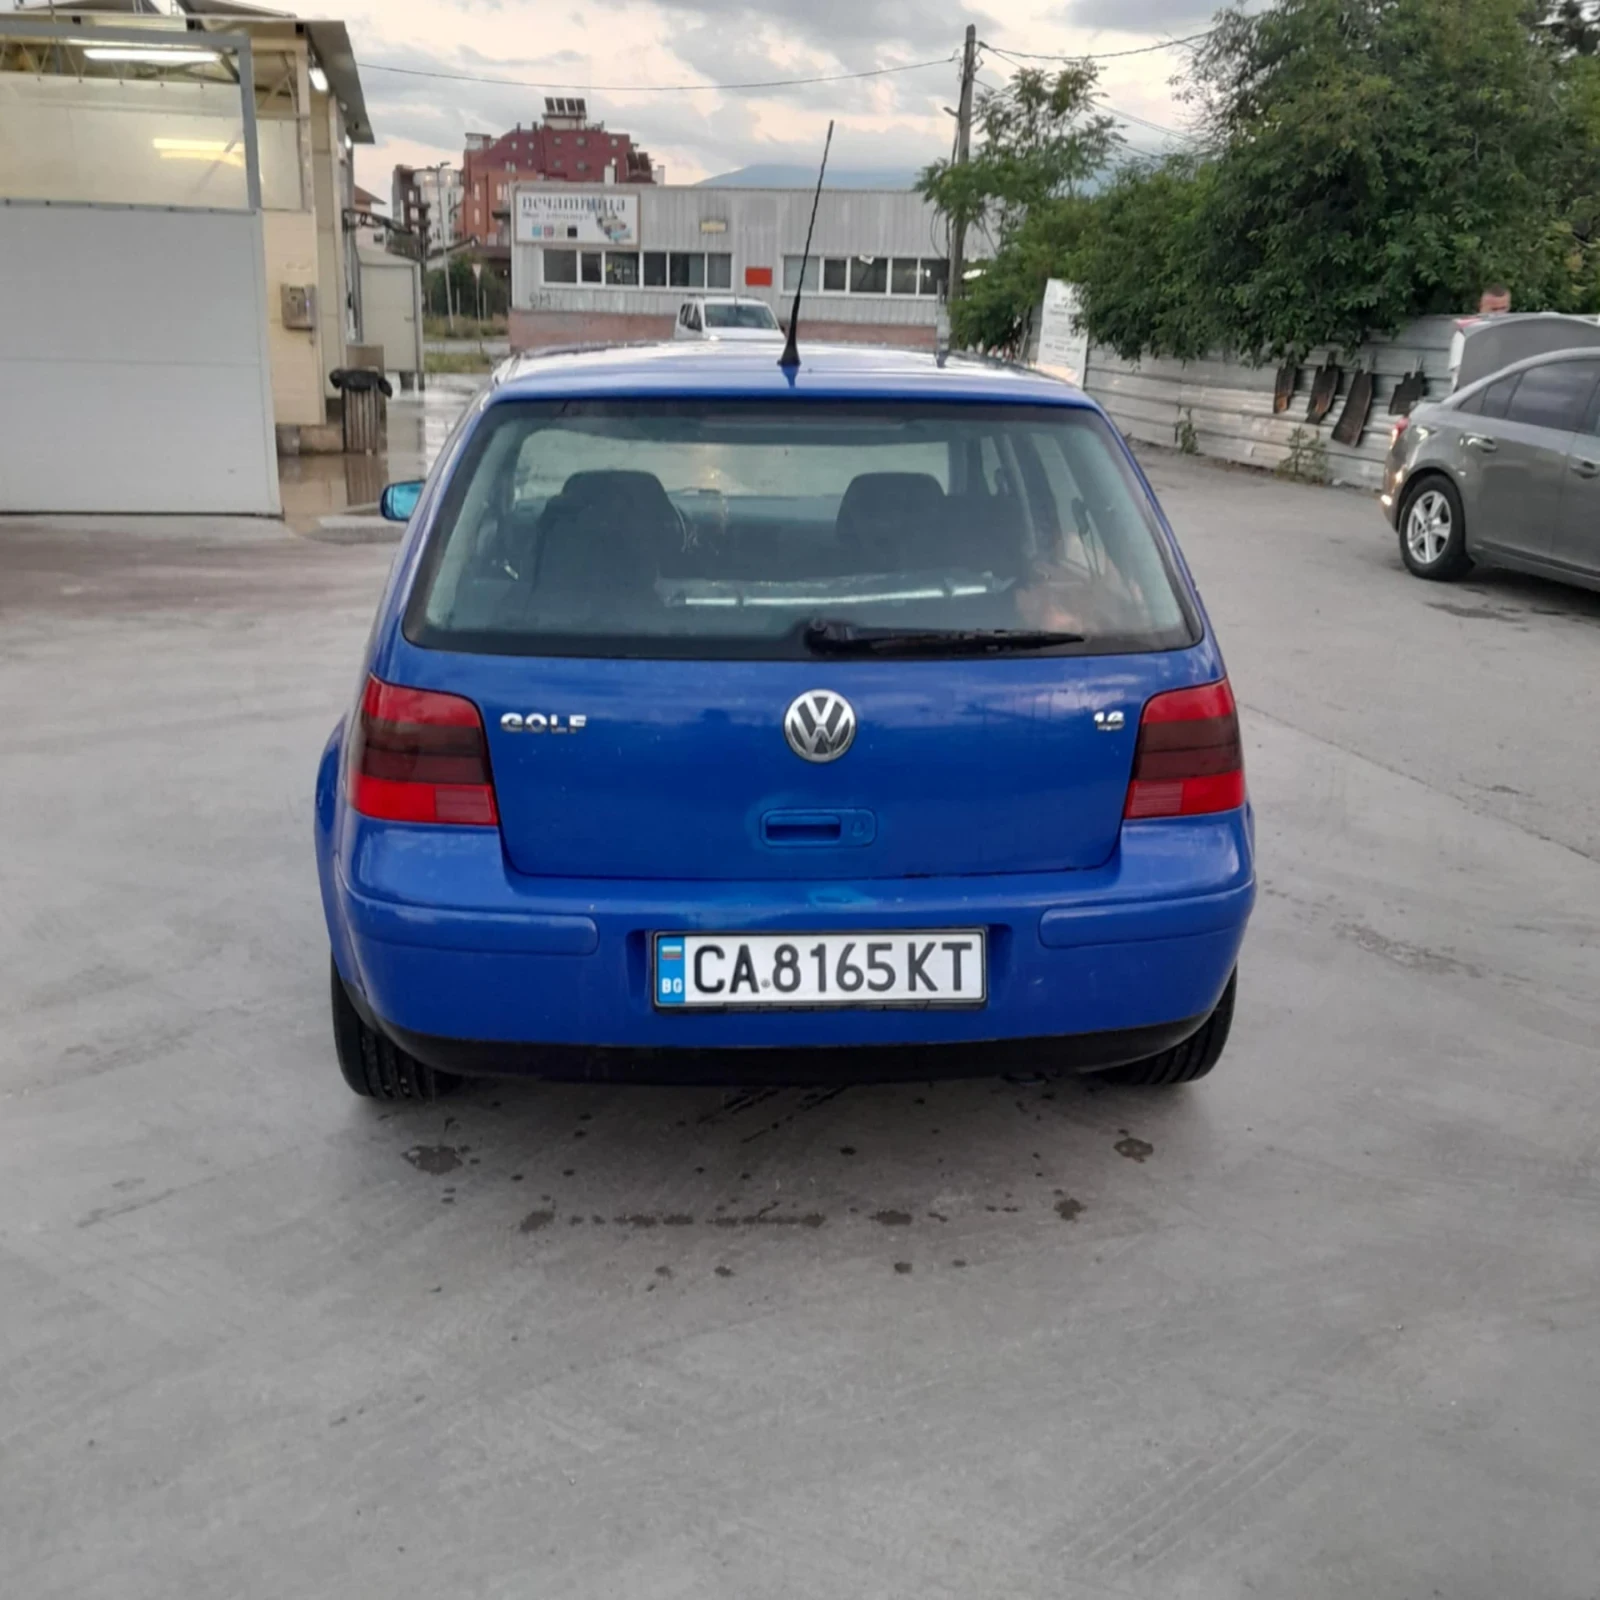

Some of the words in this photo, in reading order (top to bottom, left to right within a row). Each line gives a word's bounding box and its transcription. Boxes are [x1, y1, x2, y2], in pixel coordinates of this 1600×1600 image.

[500, 712, 587, 734] GOLF
[784, 689, 855, 763] VW
[661, 978, 683, 993] BG
